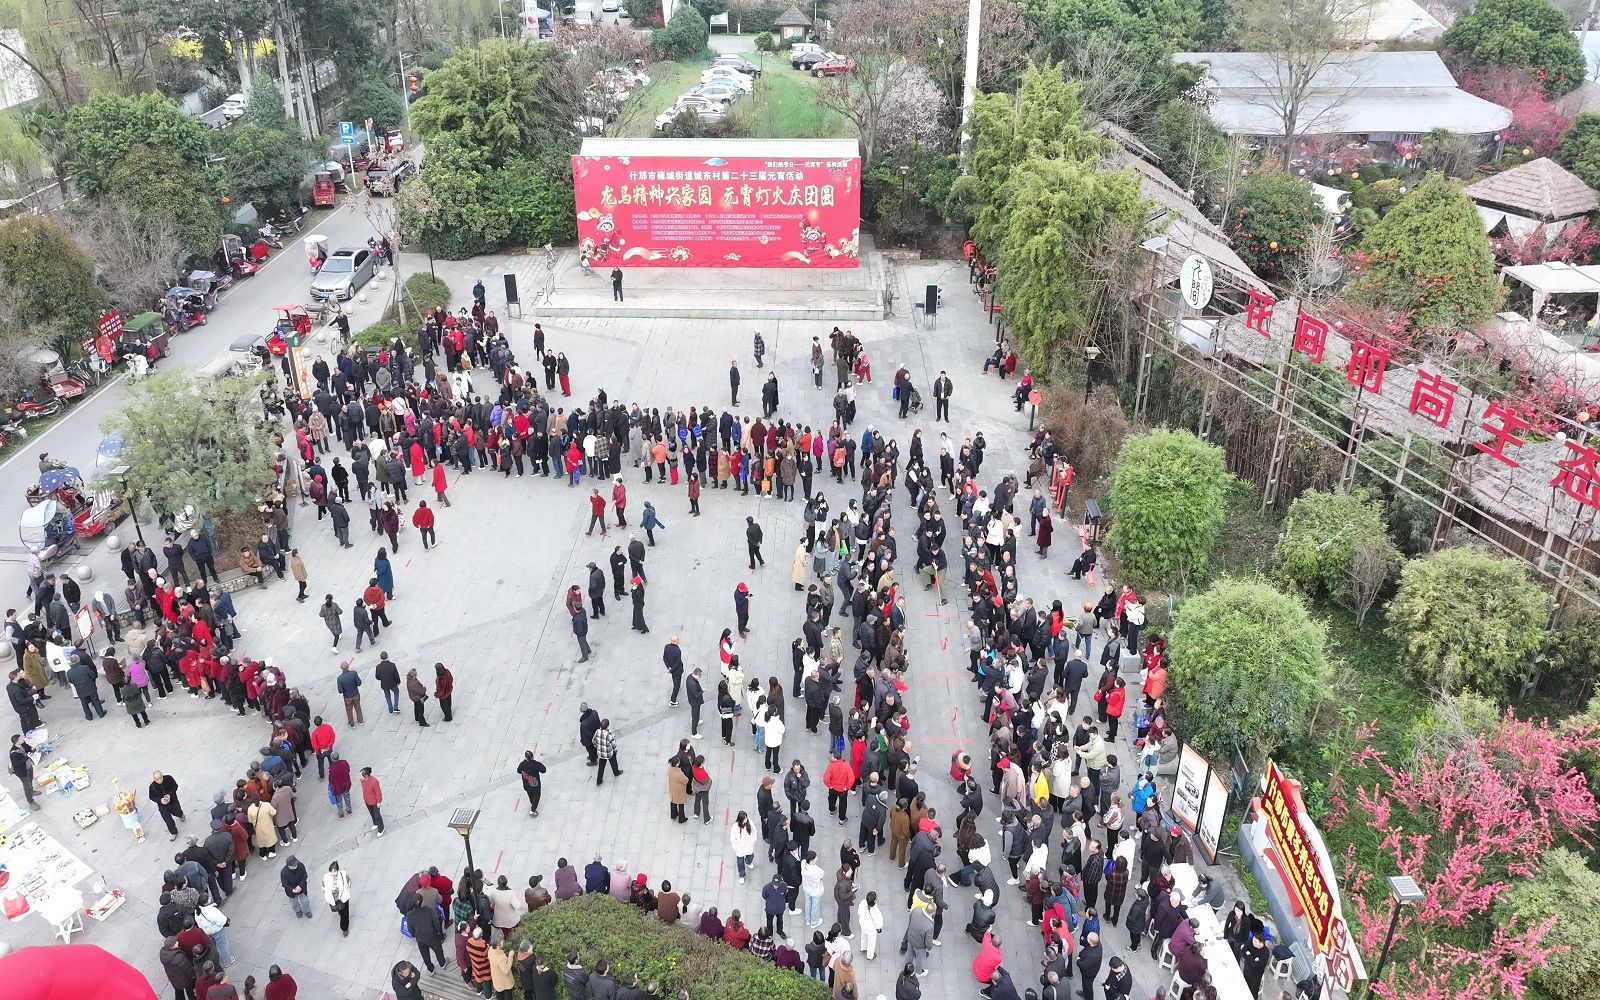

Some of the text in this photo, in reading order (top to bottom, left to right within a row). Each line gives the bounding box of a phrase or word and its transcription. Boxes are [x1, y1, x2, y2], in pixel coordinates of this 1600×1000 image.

[341, 123, 350, 133] P
[600, 183, 834, 207] 龙马精神兴家园 元宵灯火庆团圆
